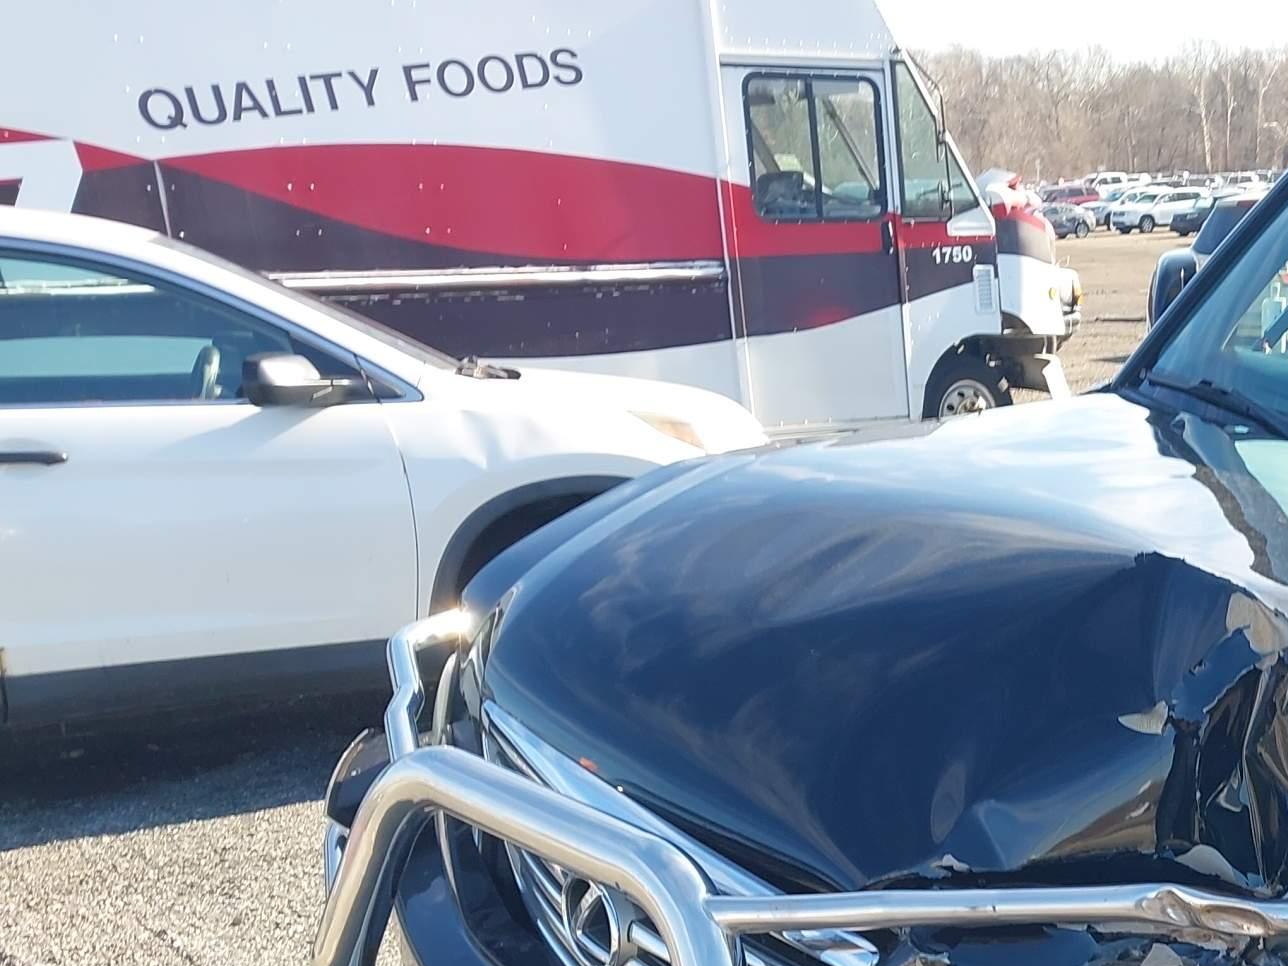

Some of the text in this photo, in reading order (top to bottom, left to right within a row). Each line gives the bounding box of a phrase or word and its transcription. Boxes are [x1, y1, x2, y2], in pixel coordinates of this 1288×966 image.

[138, 48, 583, 129] QUALITY FOODS
[932, 245, 973, 264] 1750
